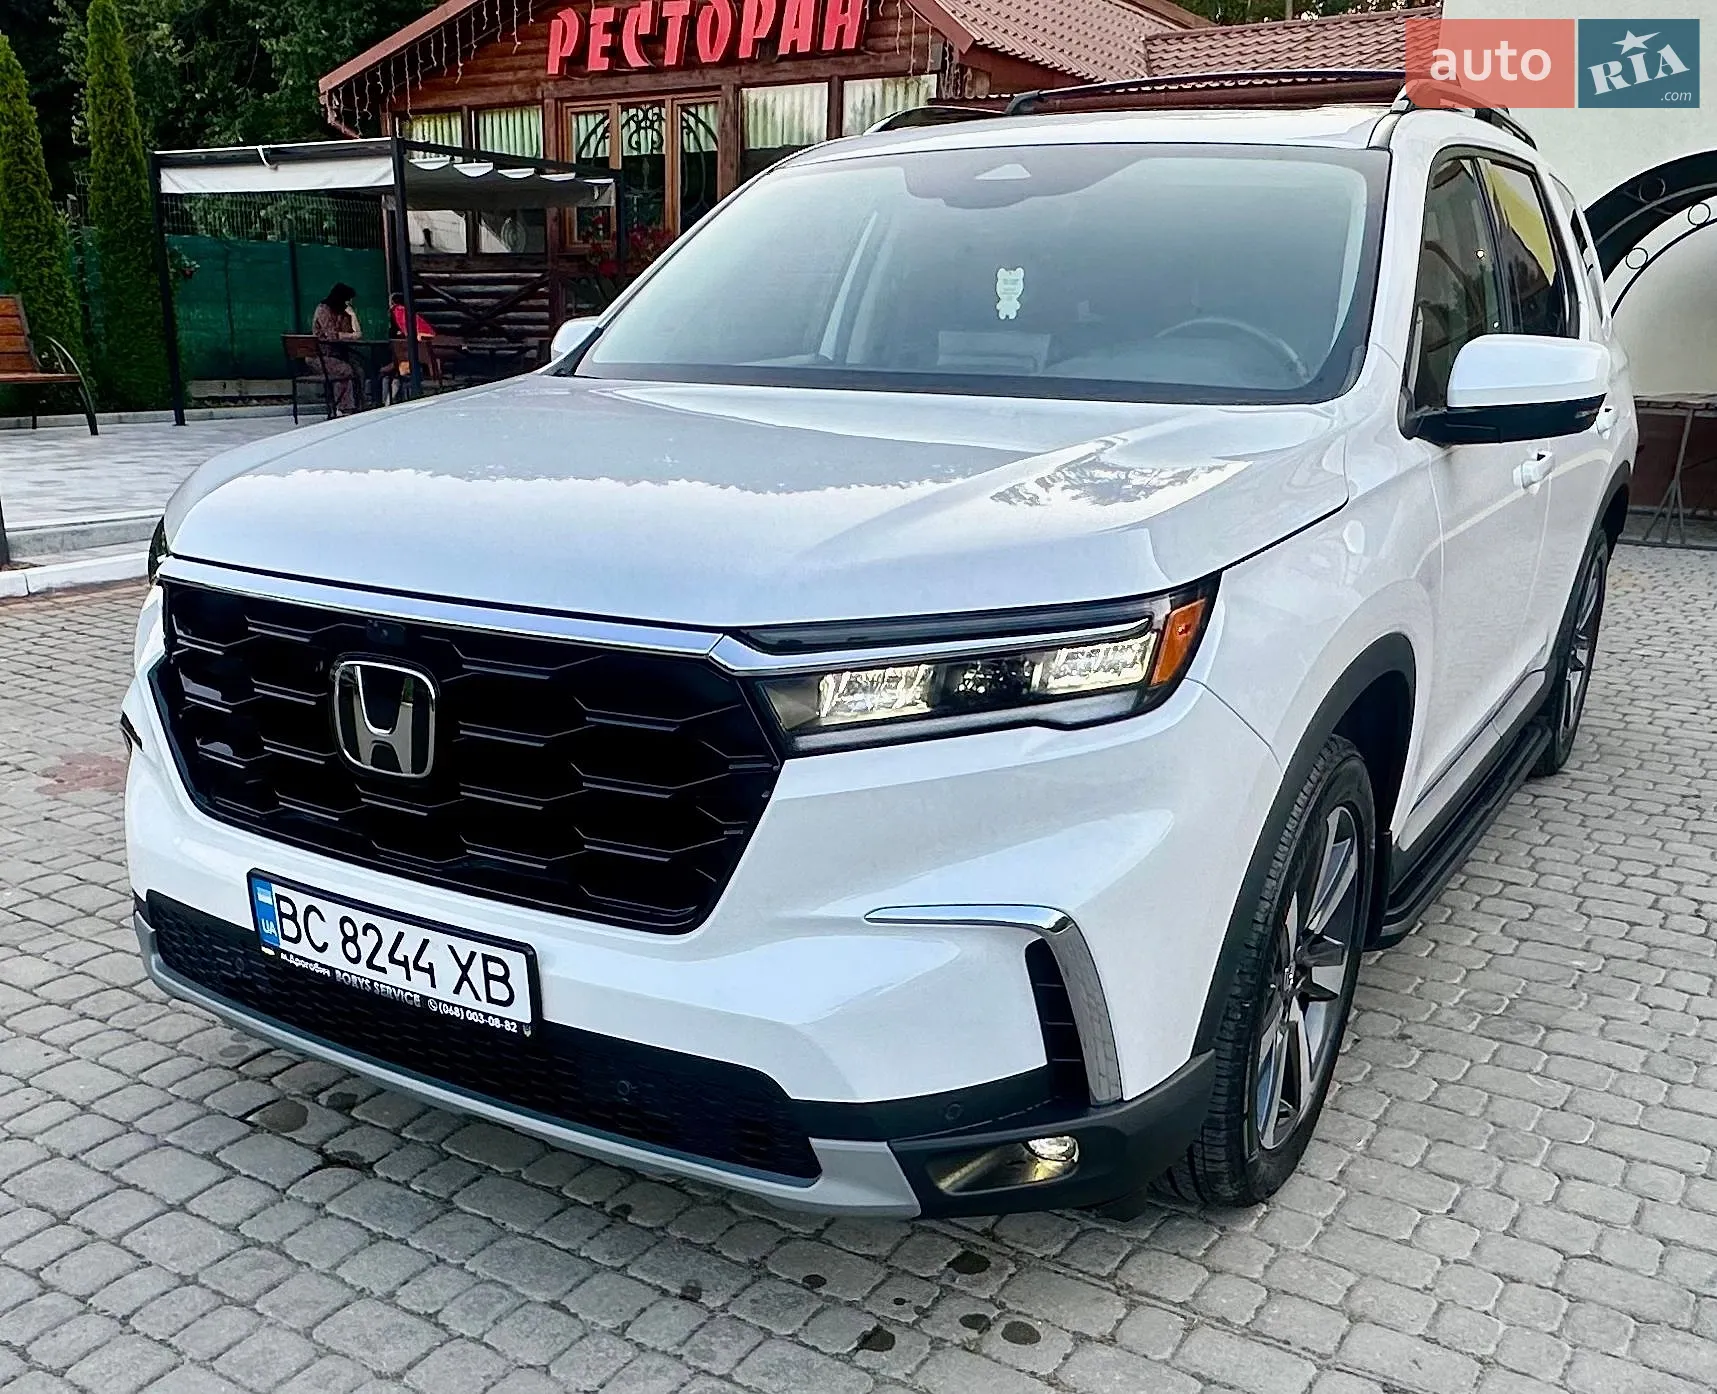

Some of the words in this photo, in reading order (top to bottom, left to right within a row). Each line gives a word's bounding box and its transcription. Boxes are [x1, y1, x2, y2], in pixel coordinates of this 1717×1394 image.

[547, 0, 865, 75] РЕСТОРАН
[261, 918, 278, 938] UA
[275, 892, 329, 954] BC
[338, 915, 437, 989] 8244
[447, 944, 515, 1008] XB
[373, 981, 422, 1008] SERVICE
